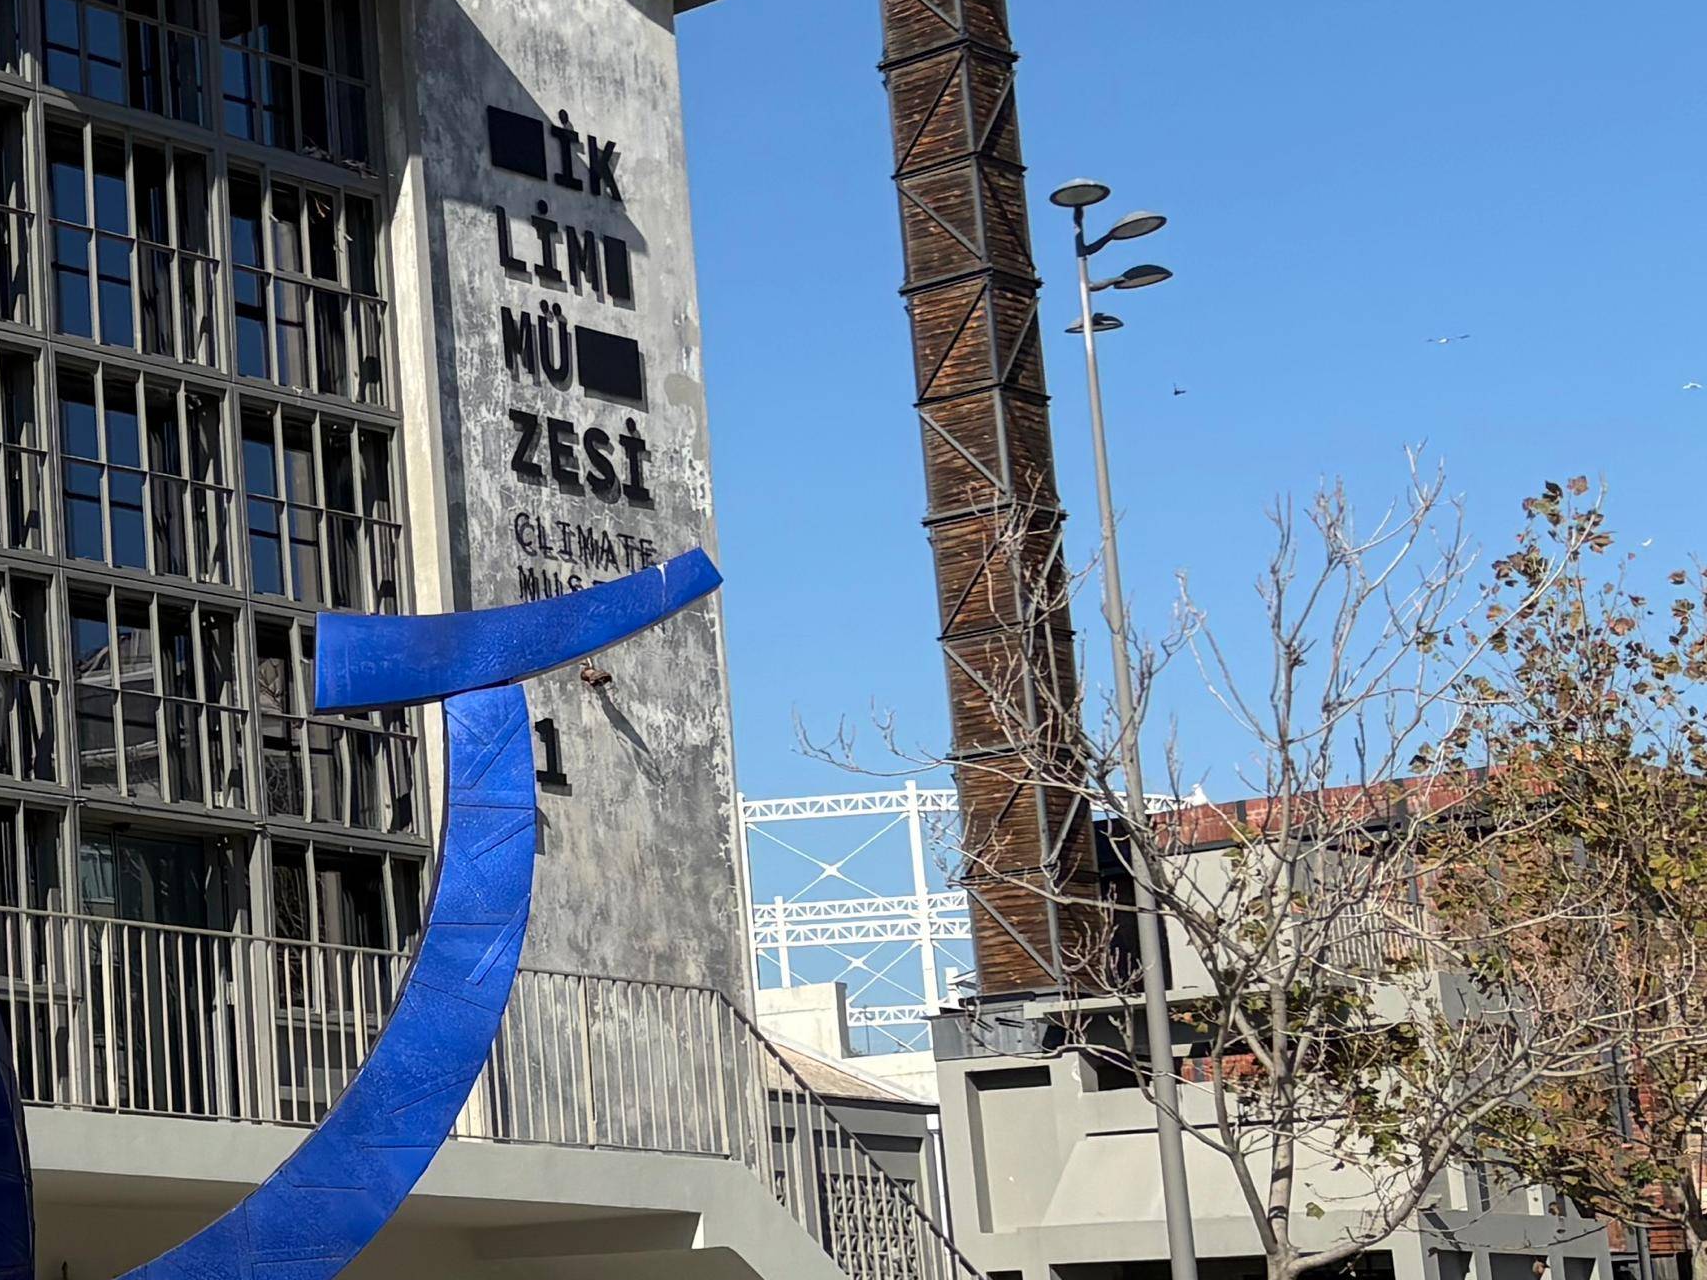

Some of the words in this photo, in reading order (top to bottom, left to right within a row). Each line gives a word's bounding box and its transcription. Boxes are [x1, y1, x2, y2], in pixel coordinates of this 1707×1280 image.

[551, 108, 624, 204] İK
[495, 198, 599, 294] LİM
[500, 298, 570, 381] MÜ
[508, 408, 651, 500] ZESİ
[514, 511, 655, 571] CLIMATE
